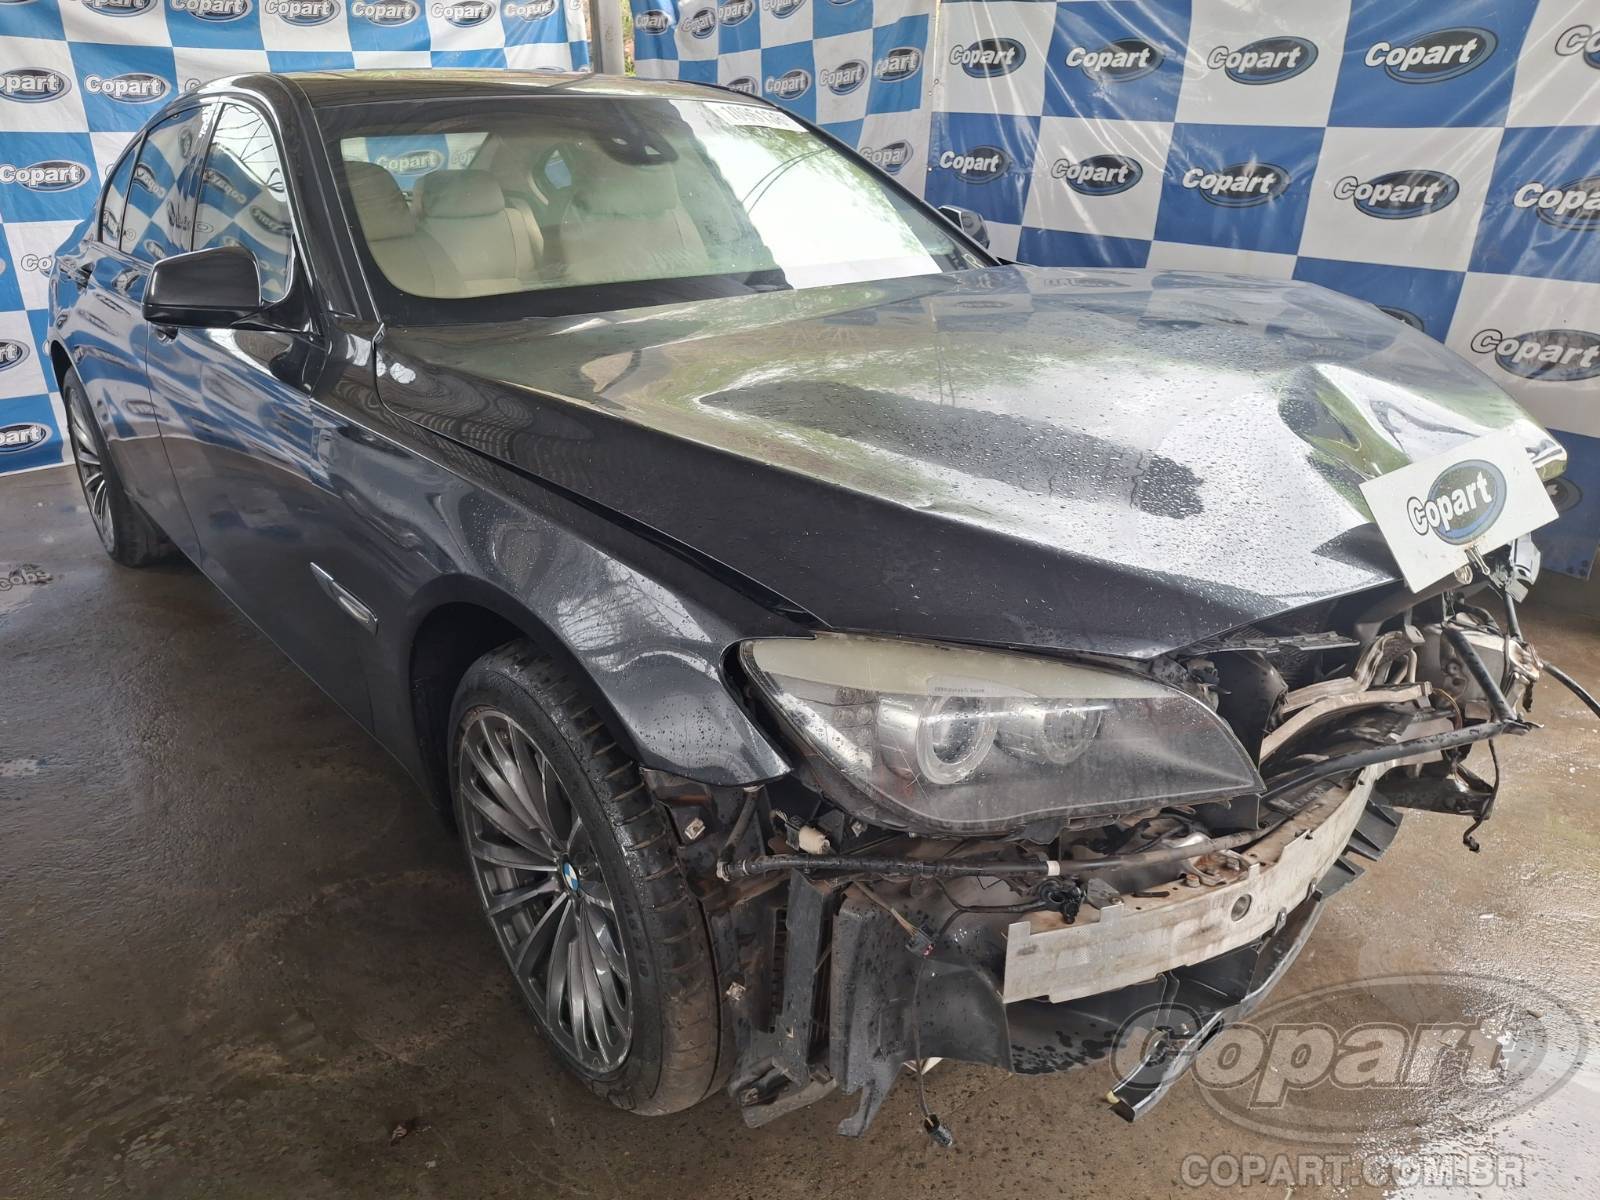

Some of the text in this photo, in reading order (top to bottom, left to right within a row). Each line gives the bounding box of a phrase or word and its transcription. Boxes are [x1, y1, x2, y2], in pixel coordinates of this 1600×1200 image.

[265, 0, 330, 17] Copart
[352, 1, 413, 20] Copart
[431, 3, 488, 21] Copart
[950, 45, 1015, 67] Copart
[1066, 47, 1150, 72] Copart
[1207, 45, 1301, 73] Copart
[1365, 37, 1478, 72] Copart
[84, 74, 161, 97] Copart
[765, 72, 806, 95] Copart
[819, 64, 862, 88] Copart
[939, 151, 1000, 174] Copart
[1051, 158, 1129, 184] Copart
[0, 163, 80, 187] Copart
[1182, 168, 1277, 195] Copart
[1334, 176, 1442, 206] Copart
[1470, 328, 1600, 368] Copart
[1407, 472, 1493, 536] Copart
